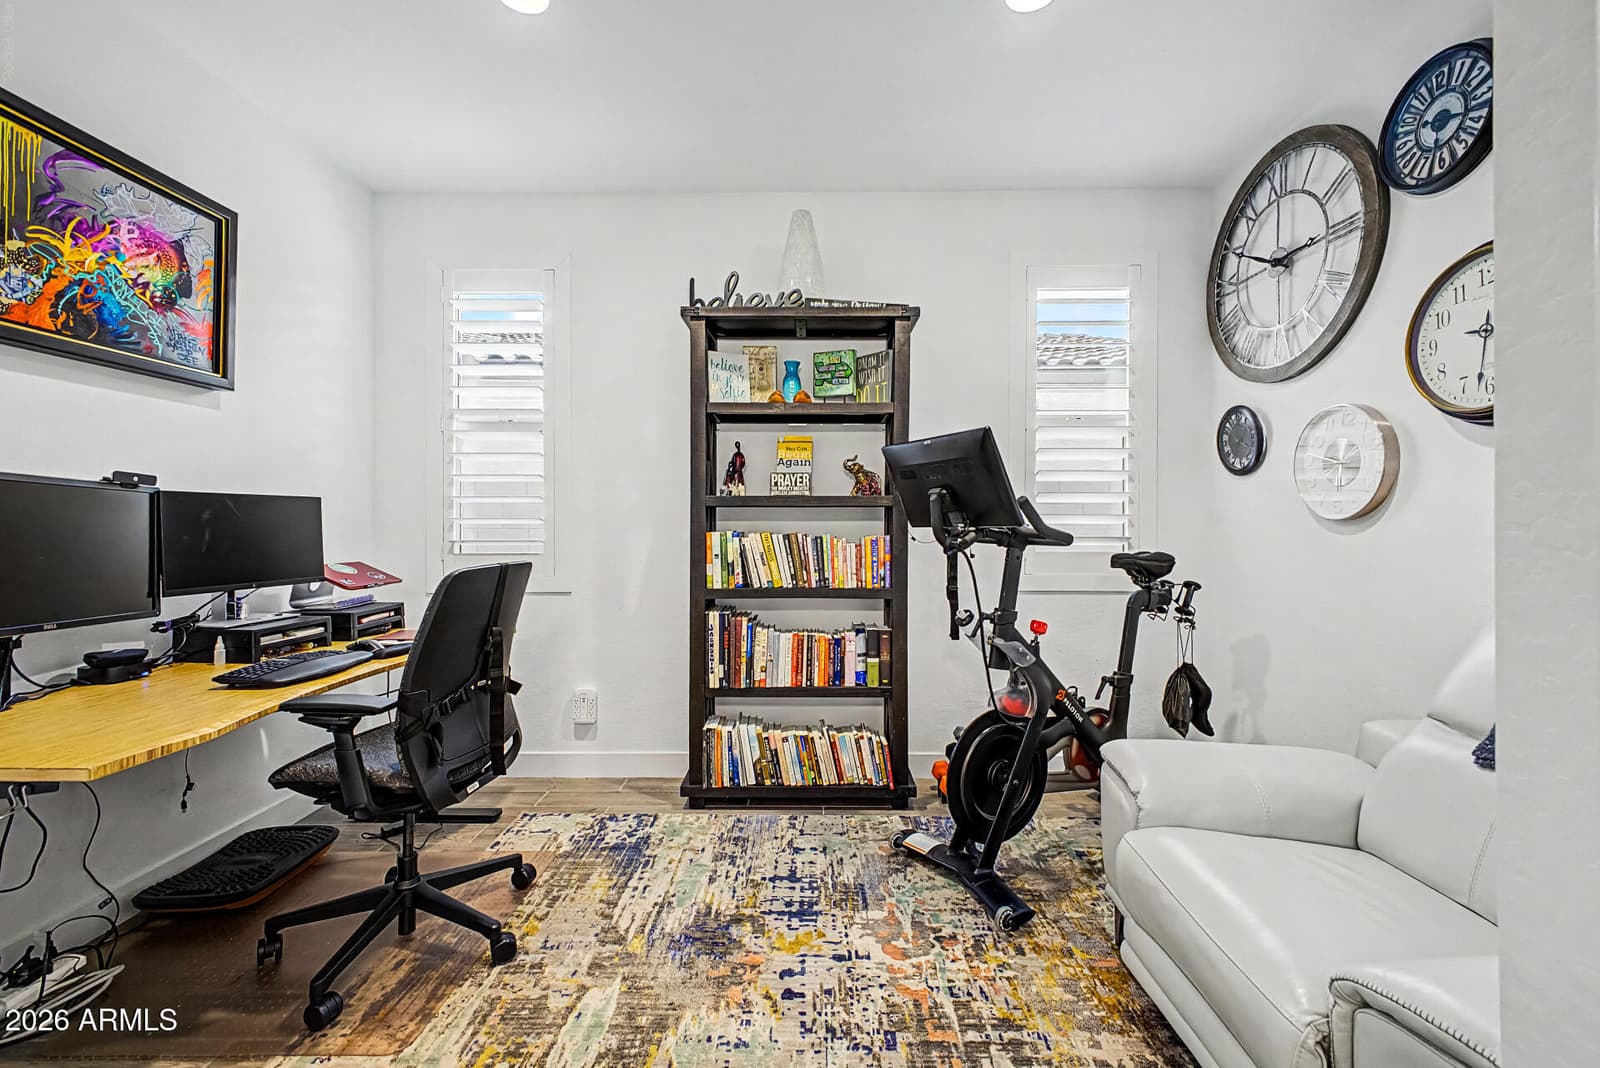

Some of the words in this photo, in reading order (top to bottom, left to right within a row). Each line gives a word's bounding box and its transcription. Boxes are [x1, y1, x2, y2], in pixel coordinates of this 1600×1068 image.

[1434, 70, 1446, 92] 12
[1466, 65, 1485, 89] 2
[1401, 116, 1417, 128] 10
[1397, 139, 1413, 151] 9
[1456, 132, 1470, 150] 5
[1403, 151, 1413, 170] 8
[1418, 156, 1429, 176] 7
[1437, 151, 1446, 170] 6
[1453, 284, 1466, 304] 11
[1435, 309, 1451, 330] 10
[1429, 339, 1438, 357] 9
[711, 357, 745, 373] believe
[1436, 362, 1447, 381] 8
[1460, 376, 1468, 395] 7
[1485, 376, 1495, 395] 6
[777, 458, 811, 468] Again
[778, 450, 811, 460] Begin
[771, 473, 810, 487] PRAYER
